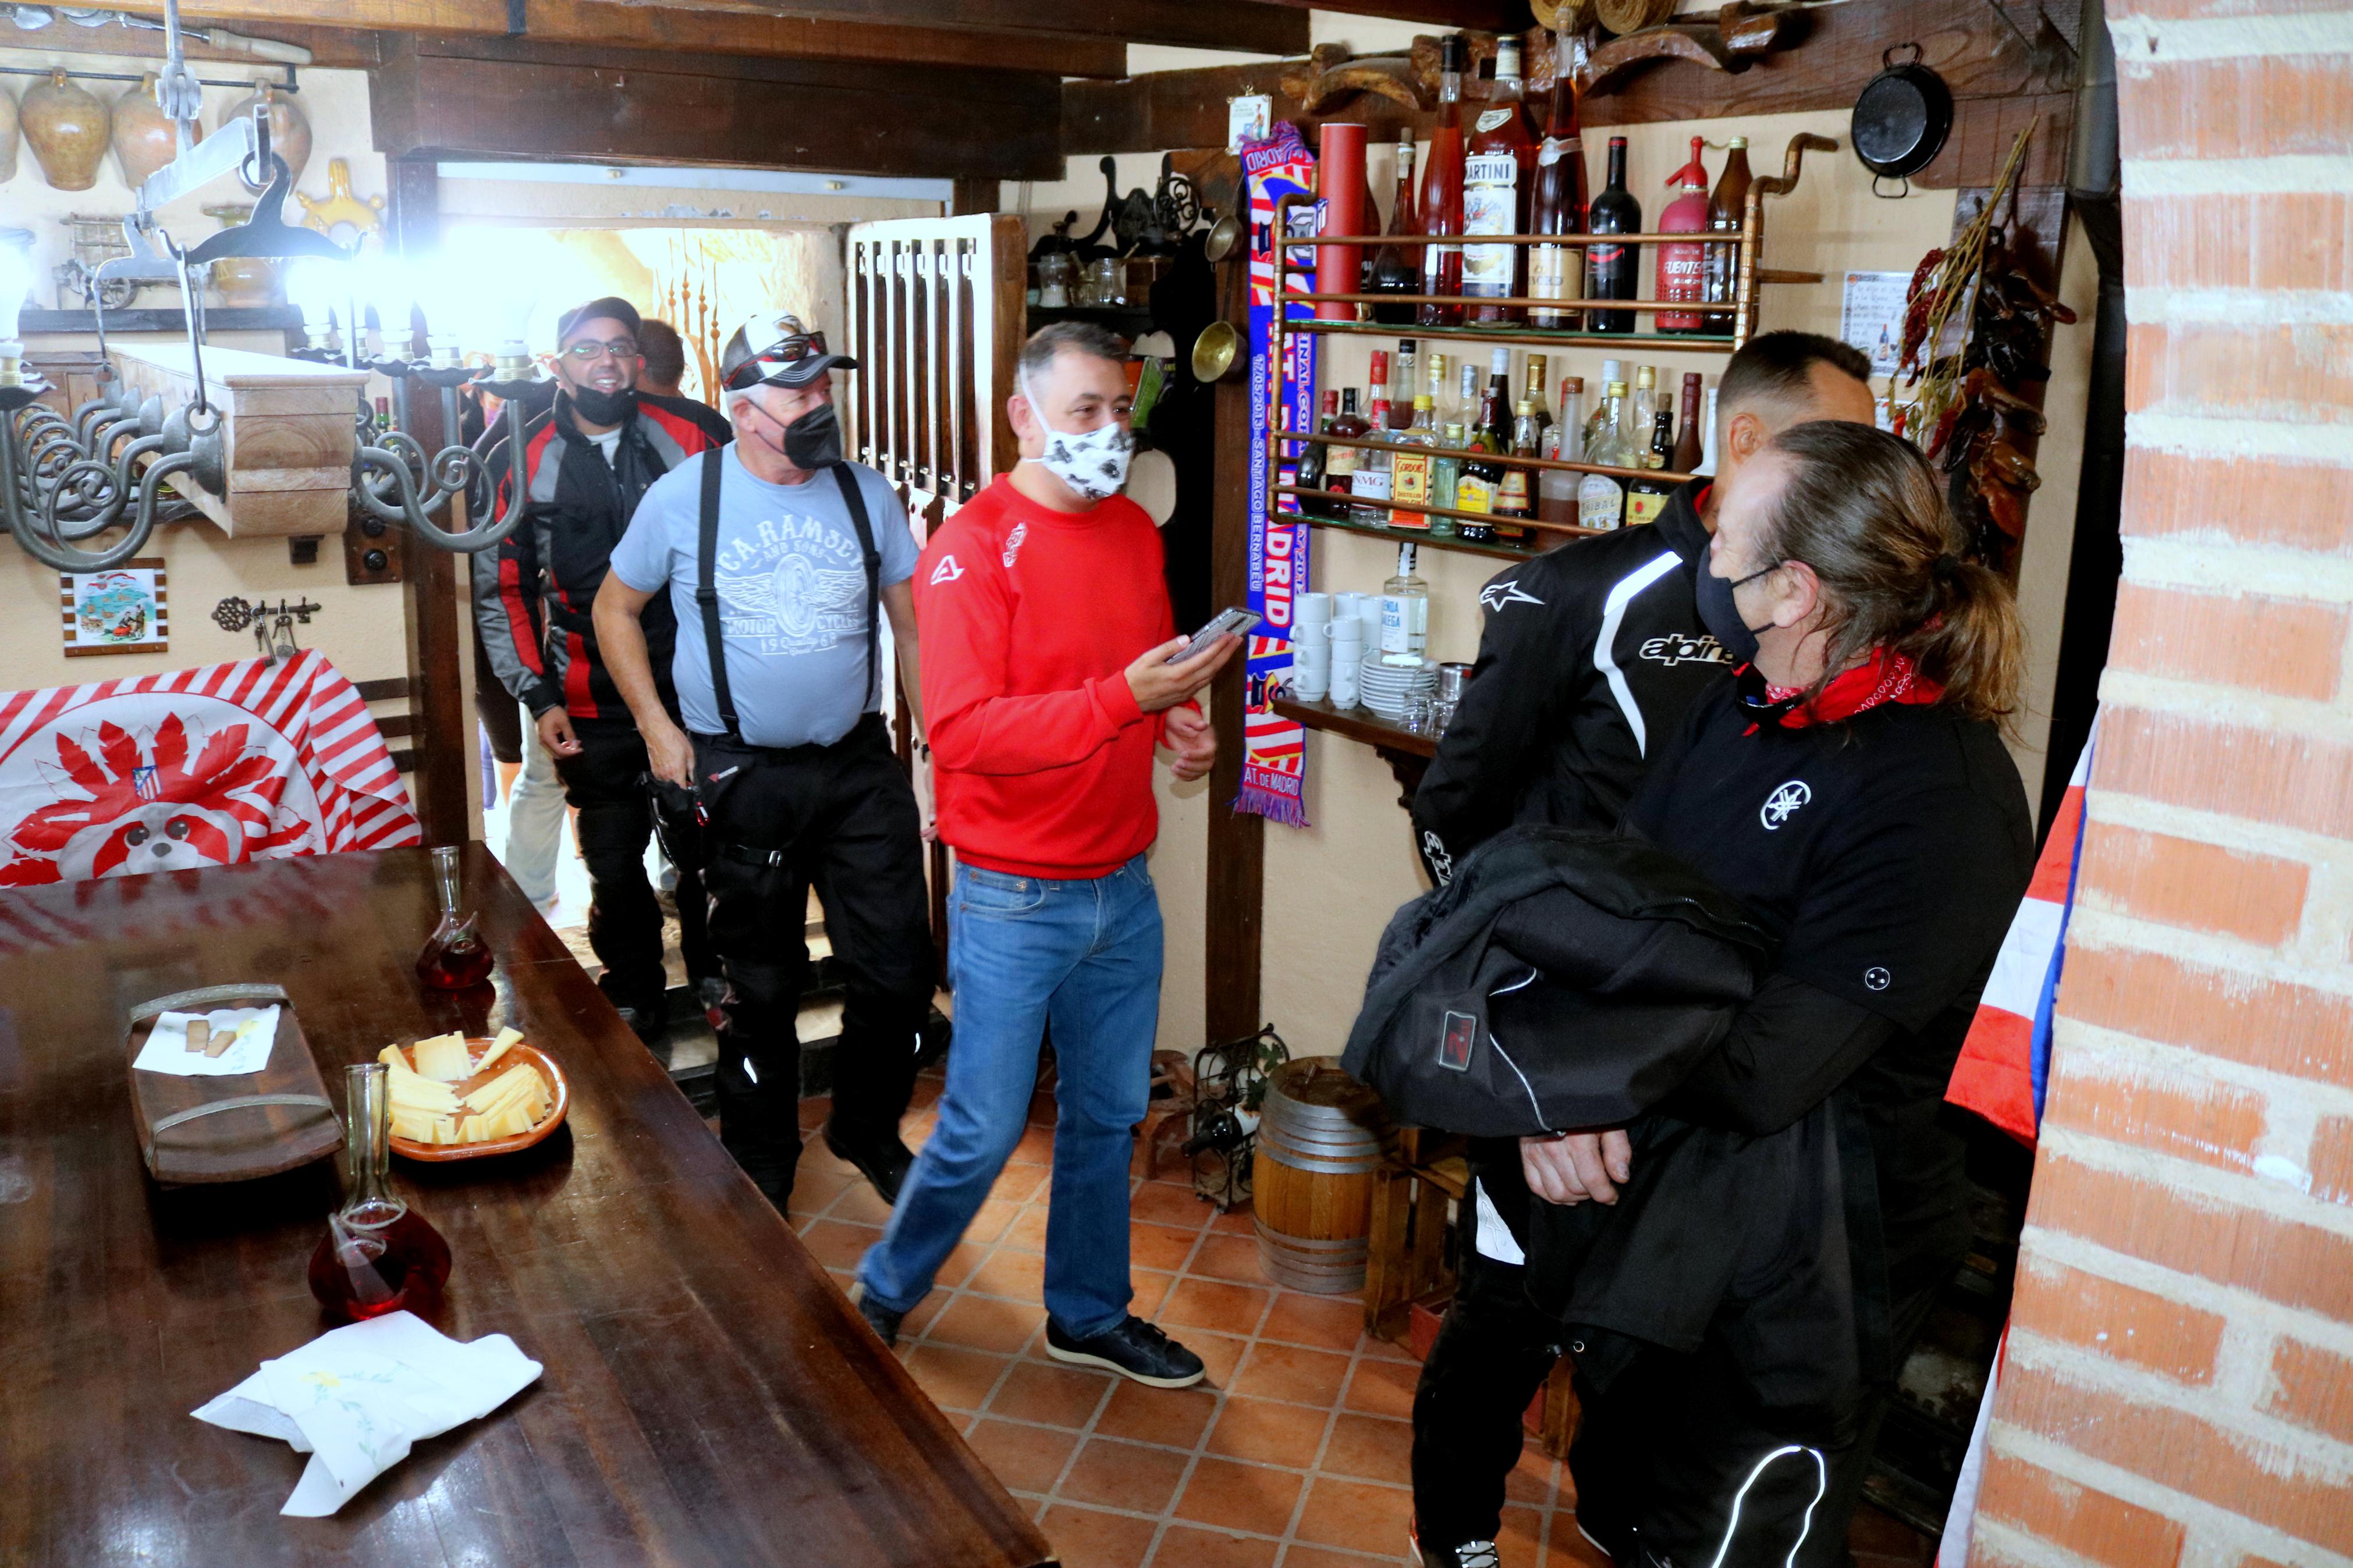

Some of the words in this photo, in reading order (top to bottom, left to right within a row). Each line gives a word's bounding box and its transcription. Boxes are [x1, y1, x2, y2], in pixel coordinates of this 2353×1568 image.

[1246, 148, 1291, 172] ADRID
[1465, 163, 1510, 180] ARTINI
[1253, 354, 1265, 429] 17/05/2013
[1252, 439, 1264, 513] SANTIAGO
[763, 542, 789, 562] AND
[793, 539, 826, 559] SONS
[727, 617, 778, 635] MOTOR
[816, 613, 859, 631] CYCLES
[1259, 773, 1270, 787] DE
[1271, 773, 1299, 797] MADRID
